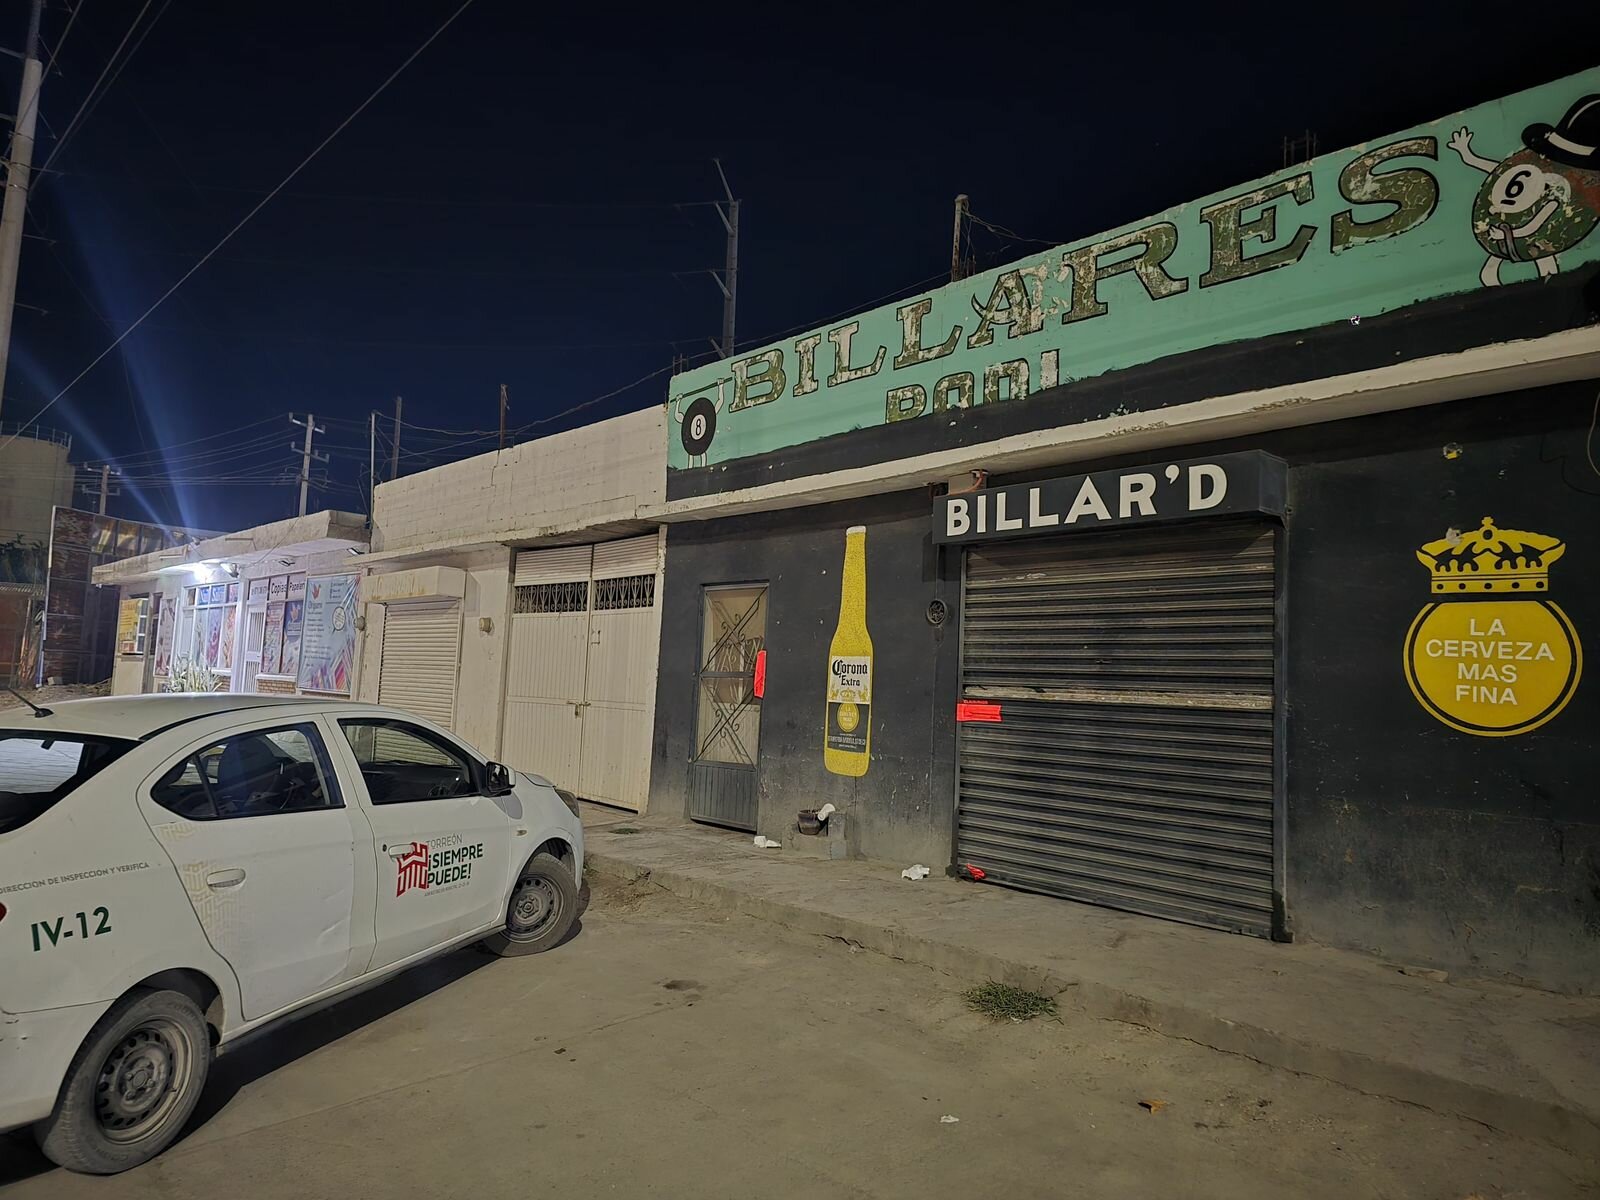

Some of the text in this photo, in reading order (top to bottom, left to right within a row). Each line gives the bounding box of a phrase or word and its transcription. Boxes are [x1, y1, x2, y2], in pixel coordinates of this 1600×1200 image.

[1504, 170, 1532, 199] 6
[729, 135, 1441, 413] BILLARES
[695, 418, 702, 436] 8
[946, 464, 1228, 537] BILLAR'D
[1469, 618, 1506, 637] LA
[1425, 638, 1555, 661] CERVEZA
[832, 659, 868, 679] Corona
[1457, 663, 1518, 684] MAS
[840, 675, 861, 687] Extra
[1455, 684, 1519, 705] FINA
[426, 833, 463, 850] TORREÓN
[428, 843, 484, 872] ¡SIEMPRE
[48, 877, 59, 886] DE
[60, 868, 109, 883] INSPECCION
[116, 862, 150, 873] VERIFICA
[428, 863, 472, 888] PUEDE!
[31, 906, 112, 952] IV-12
